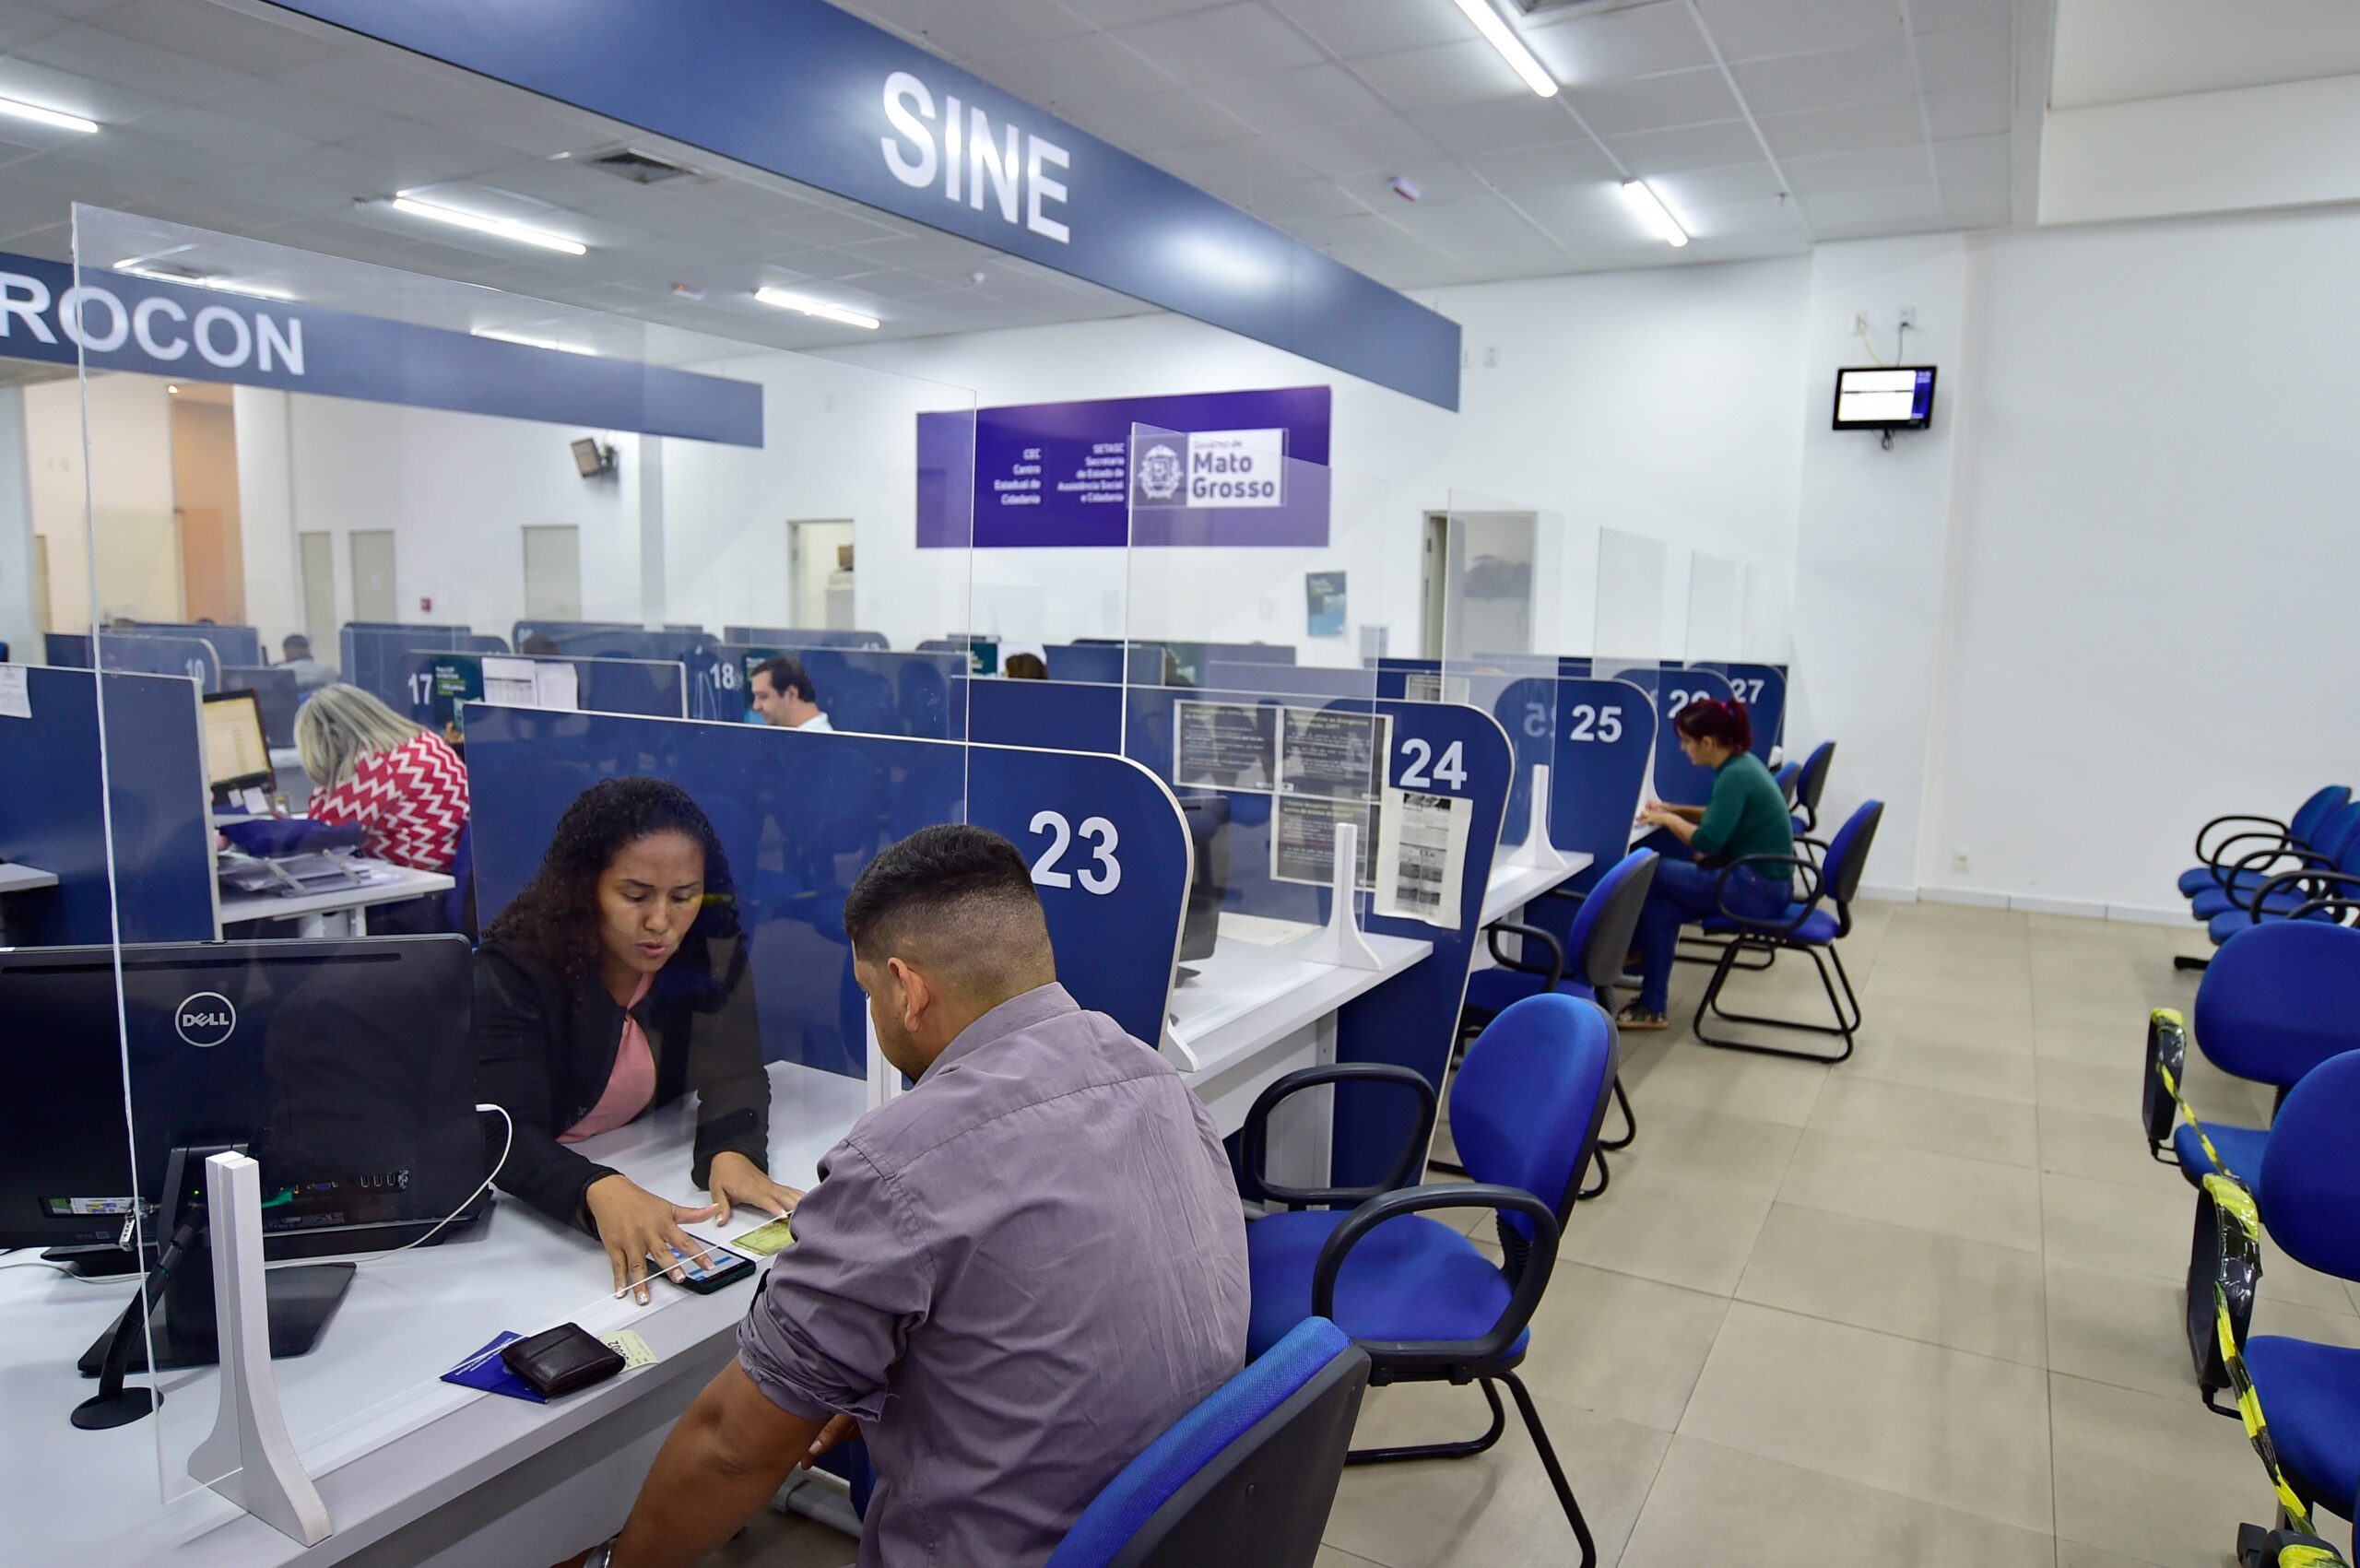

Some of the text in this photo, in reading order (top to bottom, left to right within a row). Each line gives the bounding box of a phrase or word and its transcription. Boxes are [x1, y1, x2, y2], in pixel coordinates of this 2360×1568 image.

[881, 71, 1069, 244] SINE
[0, 271, 305, 375] ROCON
[1194, 452, 1252, 473] Mato
[1193, 477, 1275, 499] Grosso
[407, 673, 433, 705] 17
[710, 663, 735, 690] 18
[1730, 678, 1765, 704] 27
[1667, 689, 1710, 721] 2
[1569, 703, 1622, 743] 25
[1399, 737, 1468, 790] 24
[1029, 810, 1122, 895] 23
[183, 1012, 230, 1028] DELL
